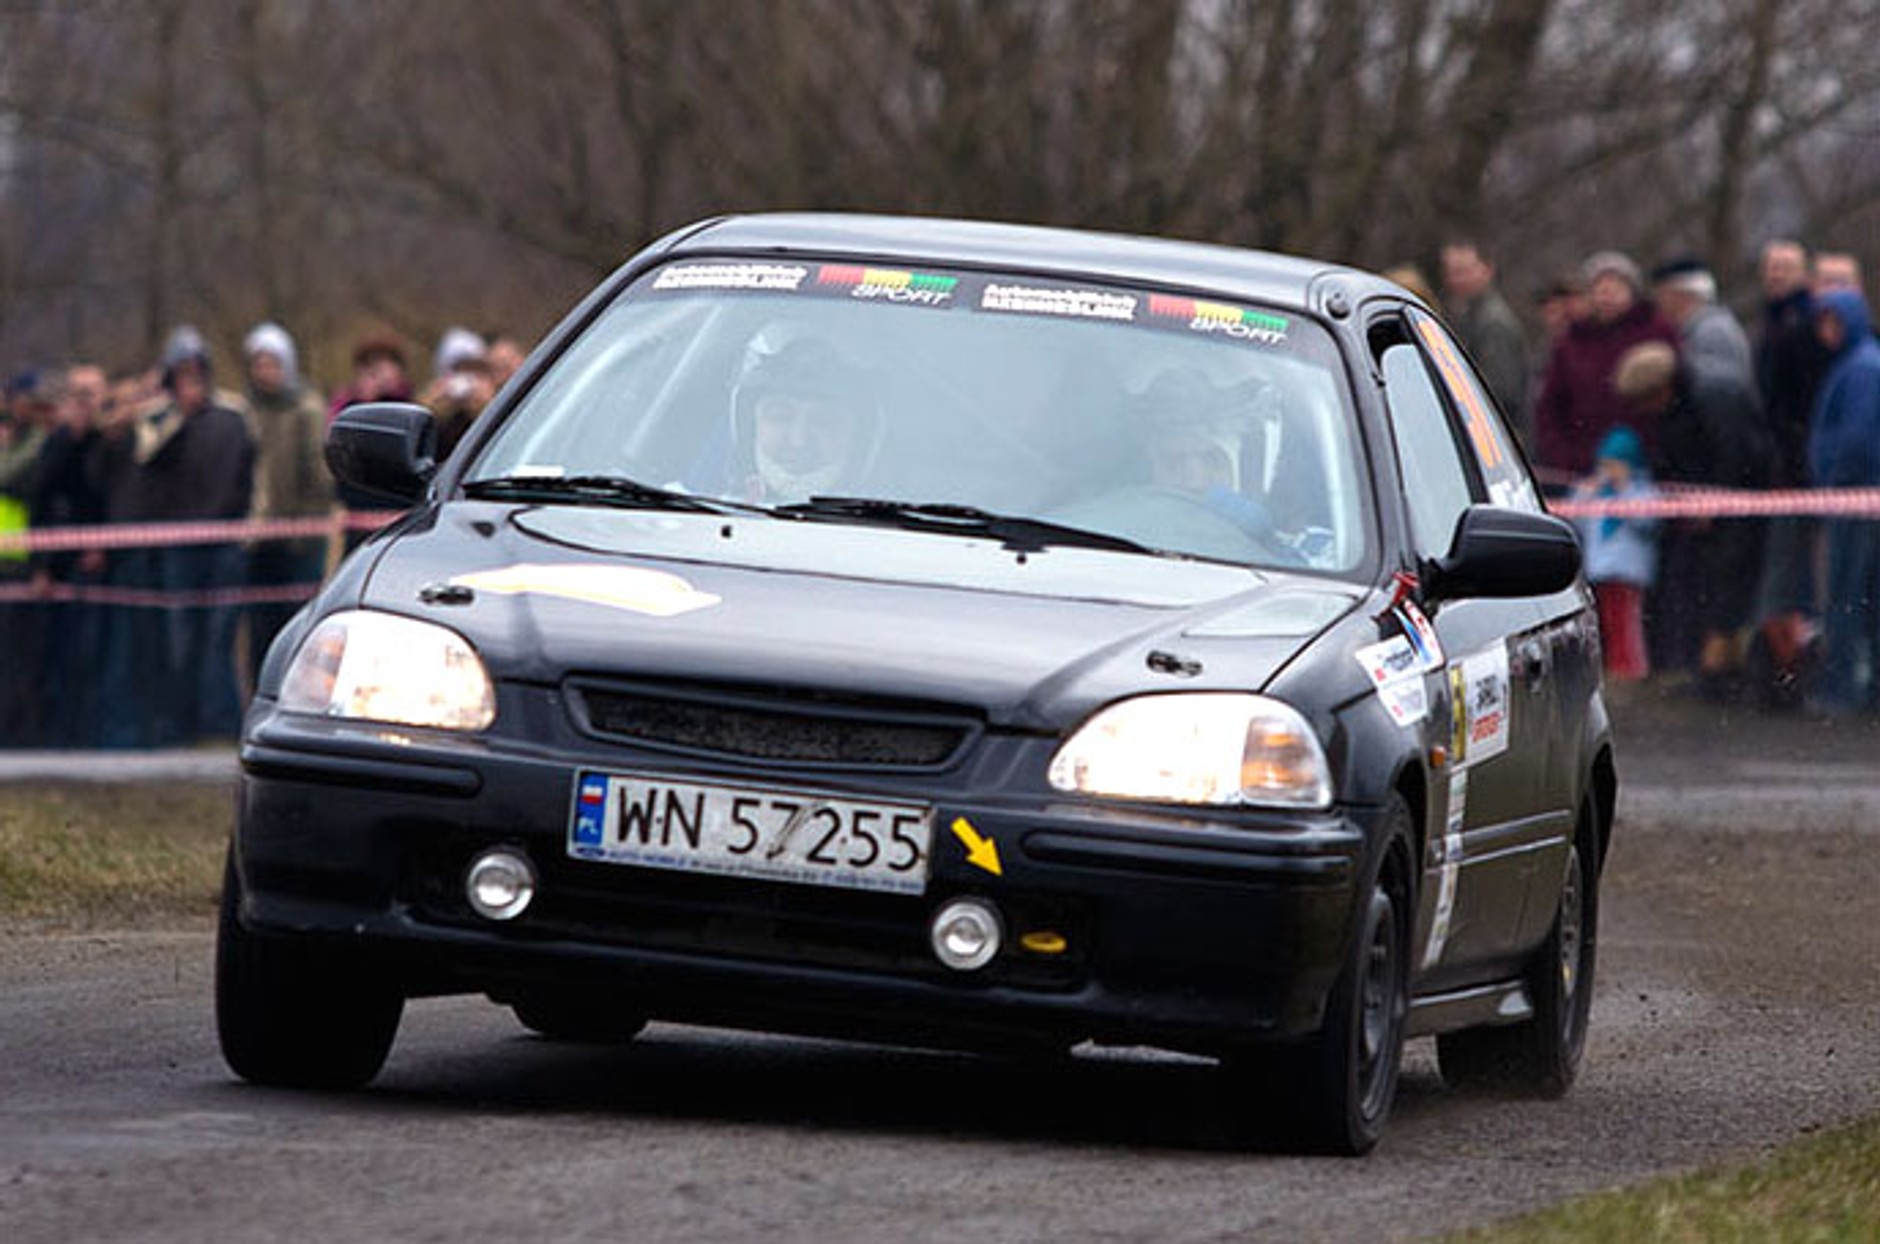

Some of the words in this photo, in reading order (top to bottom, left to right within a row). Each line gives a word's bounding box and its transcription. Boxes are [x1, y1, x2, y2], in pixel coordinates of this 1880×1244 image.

[851, 284, 950, 305] SPORT
[1190, 317, 1288, 345] SPORT
[578, 816, 600, 836] PL
[617, 786, 706, 849] WN
[727, 797, 921, 872] 57255
